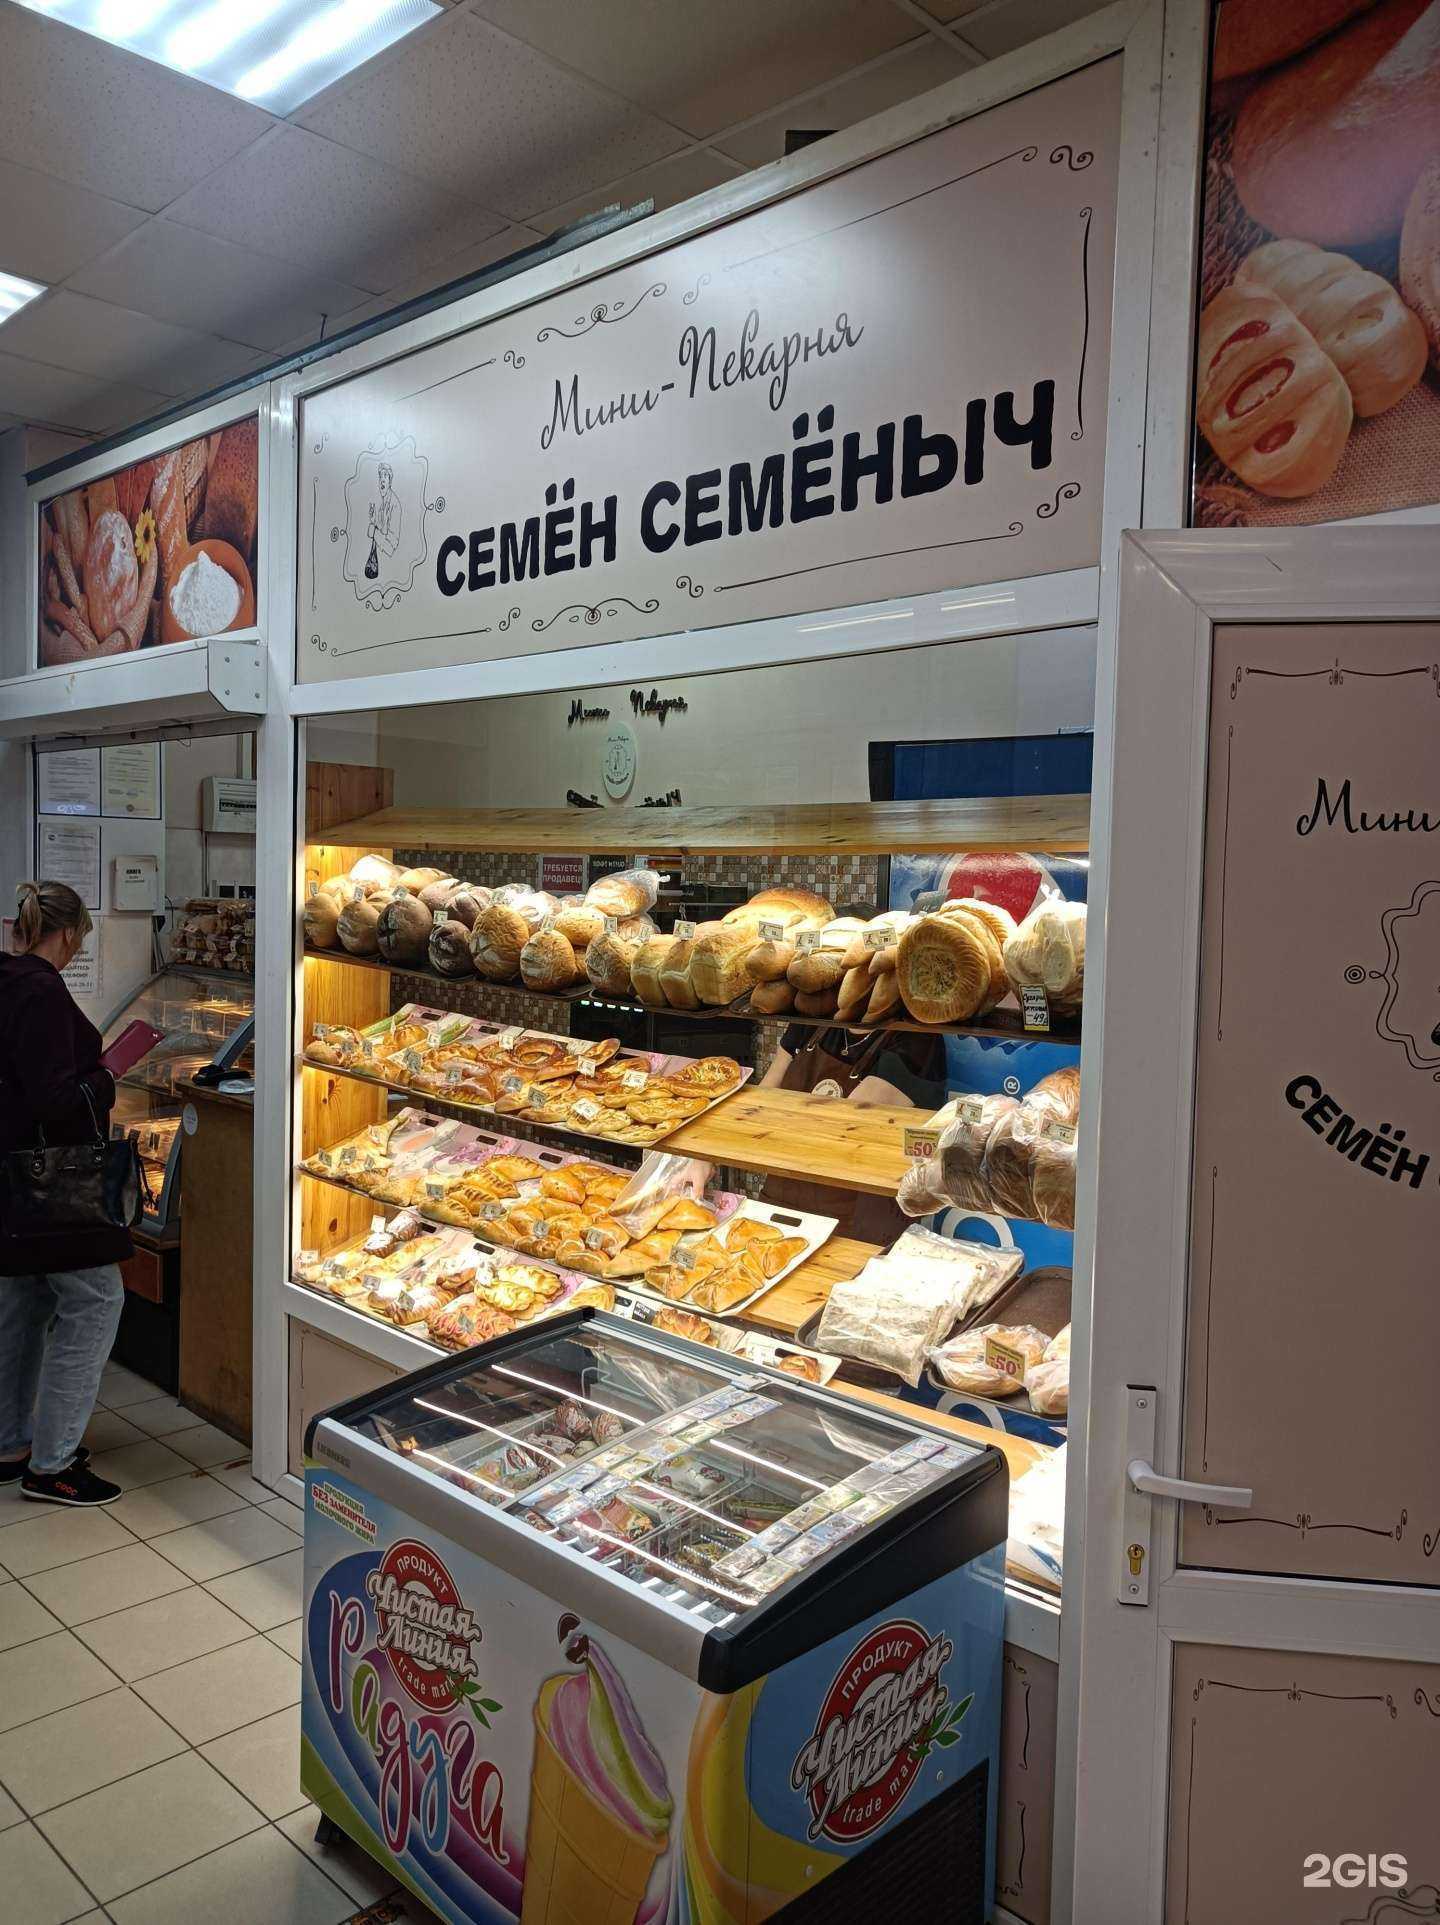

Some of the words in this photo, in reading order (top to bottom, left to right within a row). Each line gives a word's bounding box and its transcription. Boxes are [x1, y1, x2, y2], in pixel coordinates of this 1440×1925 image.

[541, 309, 864, 450] Мини-Пекарня
[436, 477, 618, 597] СЕМЁН
[639, 379, 1055, 554] СЕМЁНЫЧ
[542, 874, 582, 888] ПРОДАВЕЦ
[543, 863, 583, 877] ТРЕБУЕТСЯ
[1285, 1074, 1430, 1189] СЕМЁН
[312, 1485, 329, 1503] БЕЗ
[329, 1497, 376, 1535] ЗАМЕНИТЕЛЯ
[354, 1525, 375, 1545] ЖИРА
[396, 1555, 448, 1594] ПРОДУКТ
[367, 1570, 481, 1641] Чистая
[377, 1613, 478, 1677] Линия
[841, 1640, 913, 1700] ПРОДУКТ
[398, 1656, 427, 1695] trade
[791, 1631, 954, 1797] Чистая
[808, 1685, 948, 1840] Линия
[843, 1797, 882, 1824] trade
